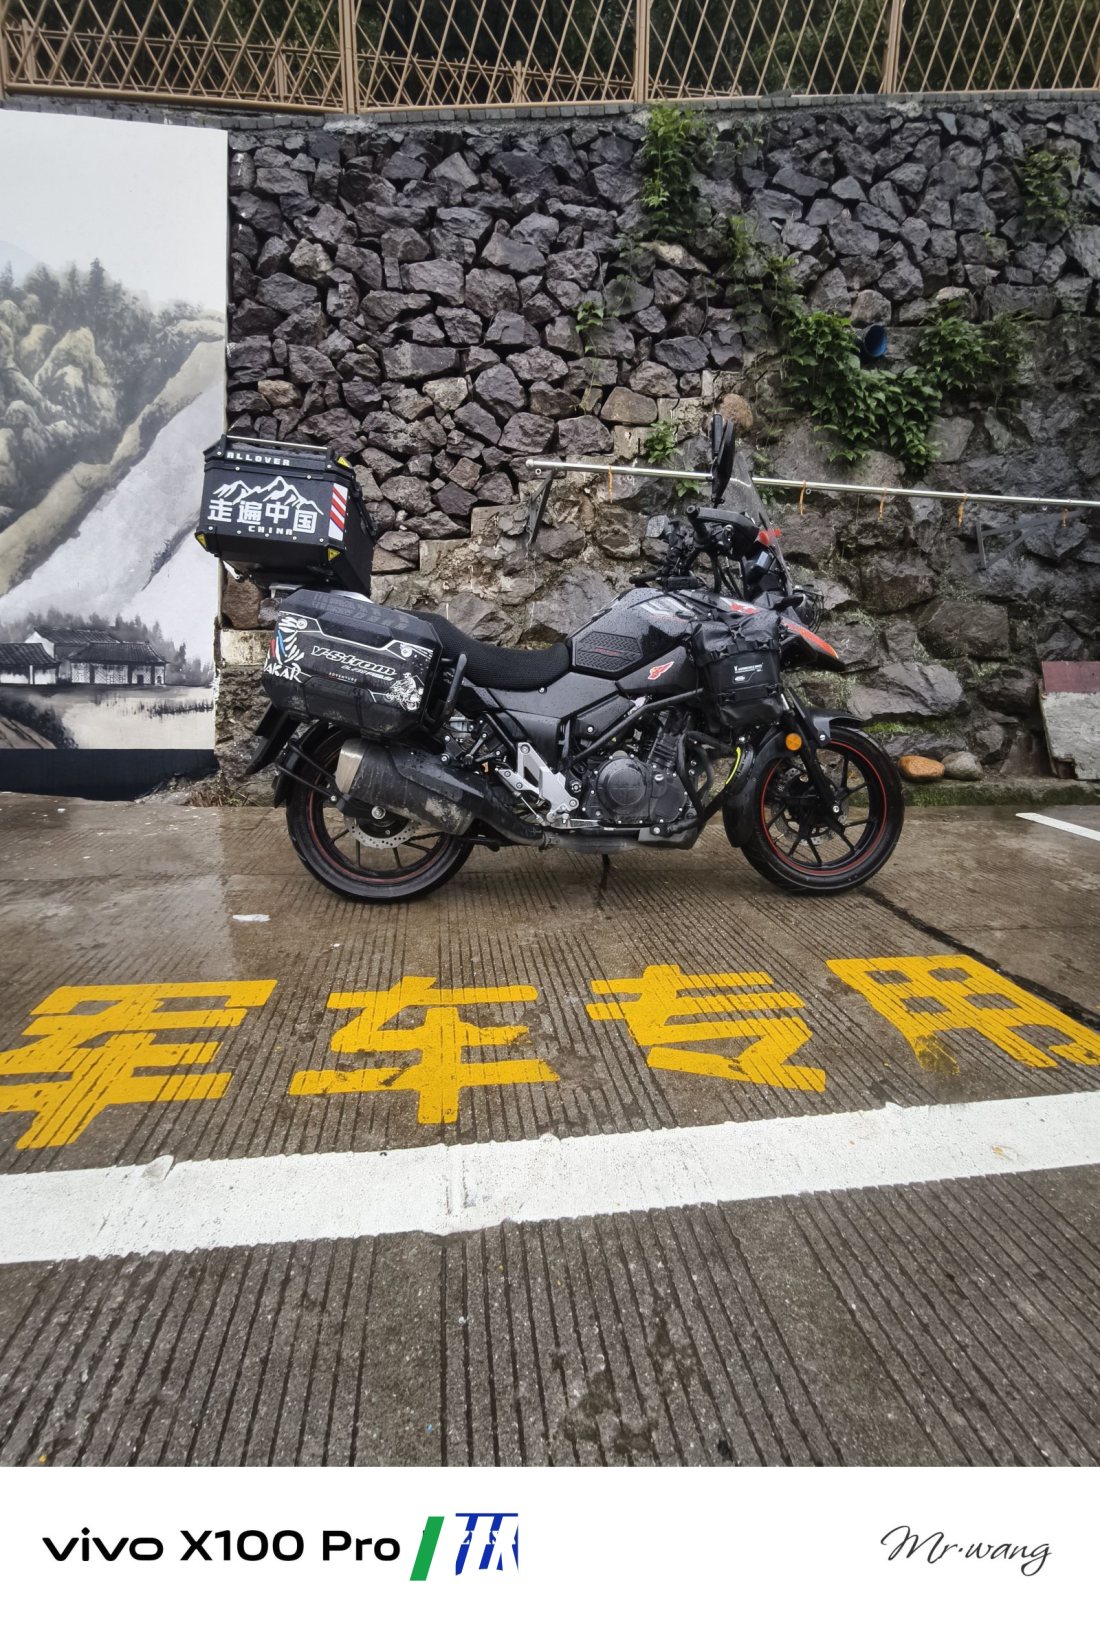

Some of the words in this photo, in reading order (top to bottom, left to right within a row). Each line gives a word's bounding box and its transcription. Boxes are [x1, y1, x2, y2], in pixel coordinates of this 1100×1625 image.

[226, 451, 291, 467] ALLOVER
[207, 498, 318, 534] 走遍中国
[248, 525, 293, 536] CHINA
[0, 955, 1100, 1149] 军车专用
